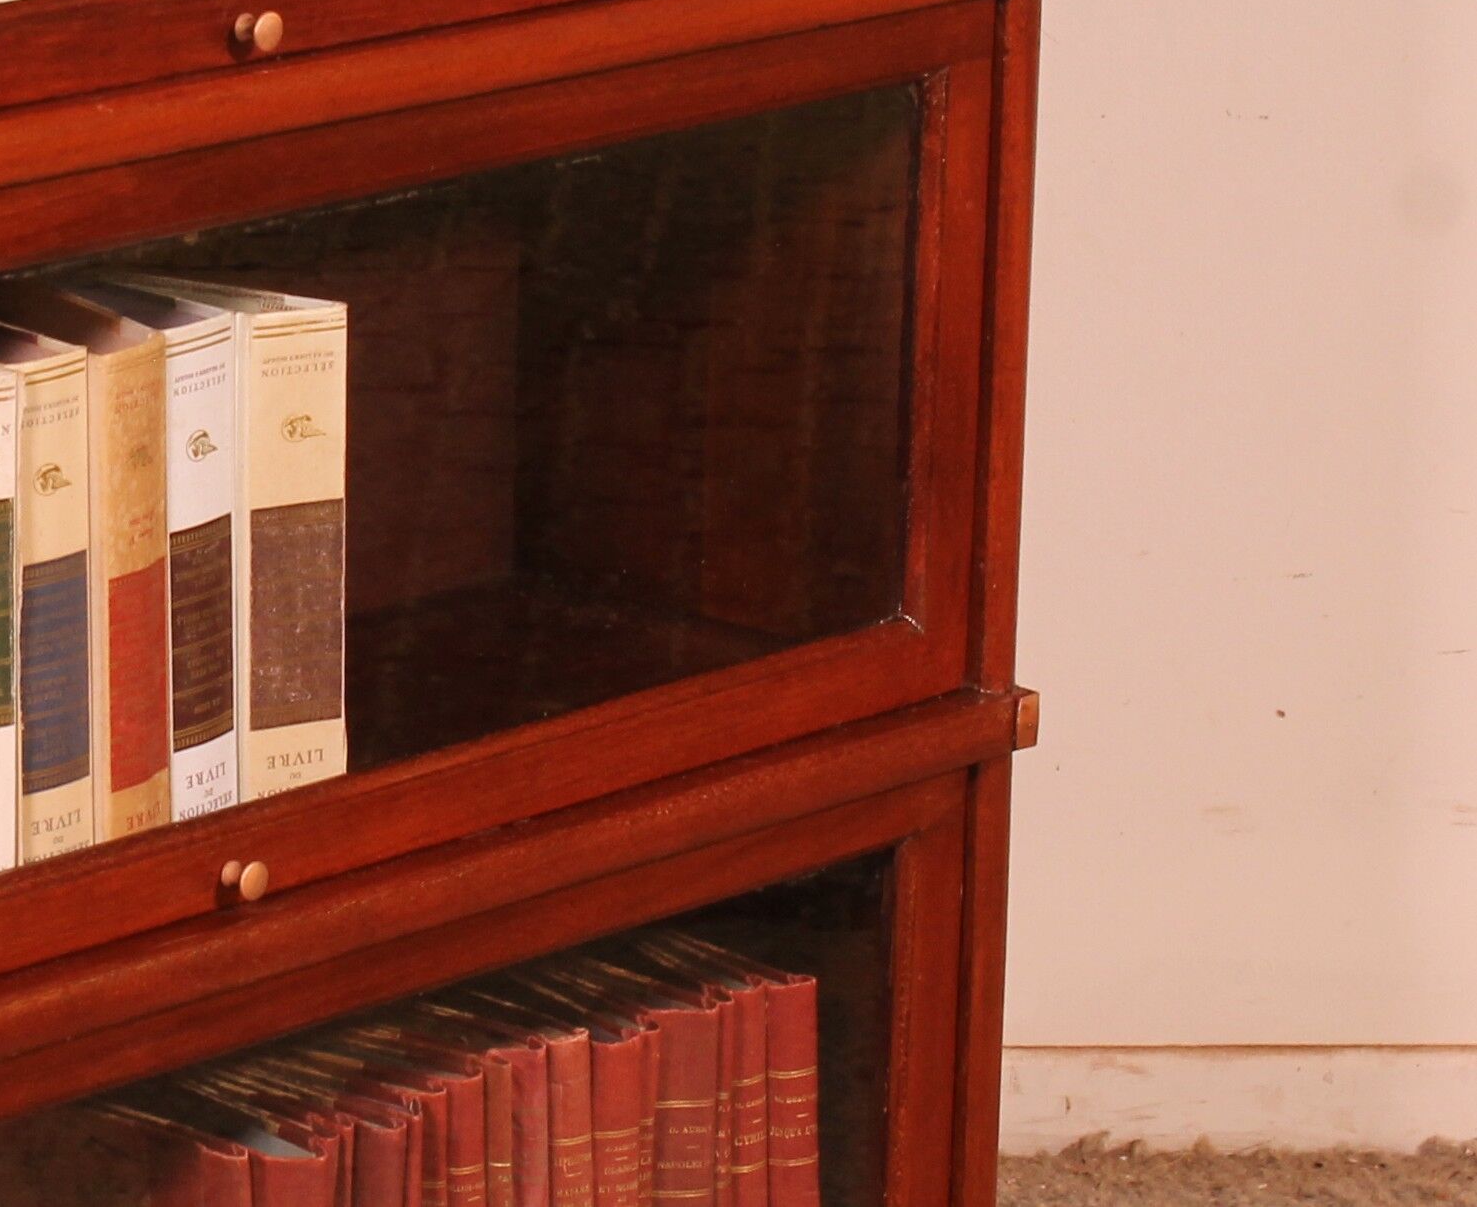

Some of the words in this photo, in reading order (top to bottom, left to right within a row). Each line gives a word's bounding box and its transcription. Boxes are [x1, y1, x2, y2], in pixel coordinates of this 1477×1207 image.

[267, 749, 324, 770] LIVRE
[187, 761, 226, 789] LIVRE
[32, 808, 81, 836] LIVRE
